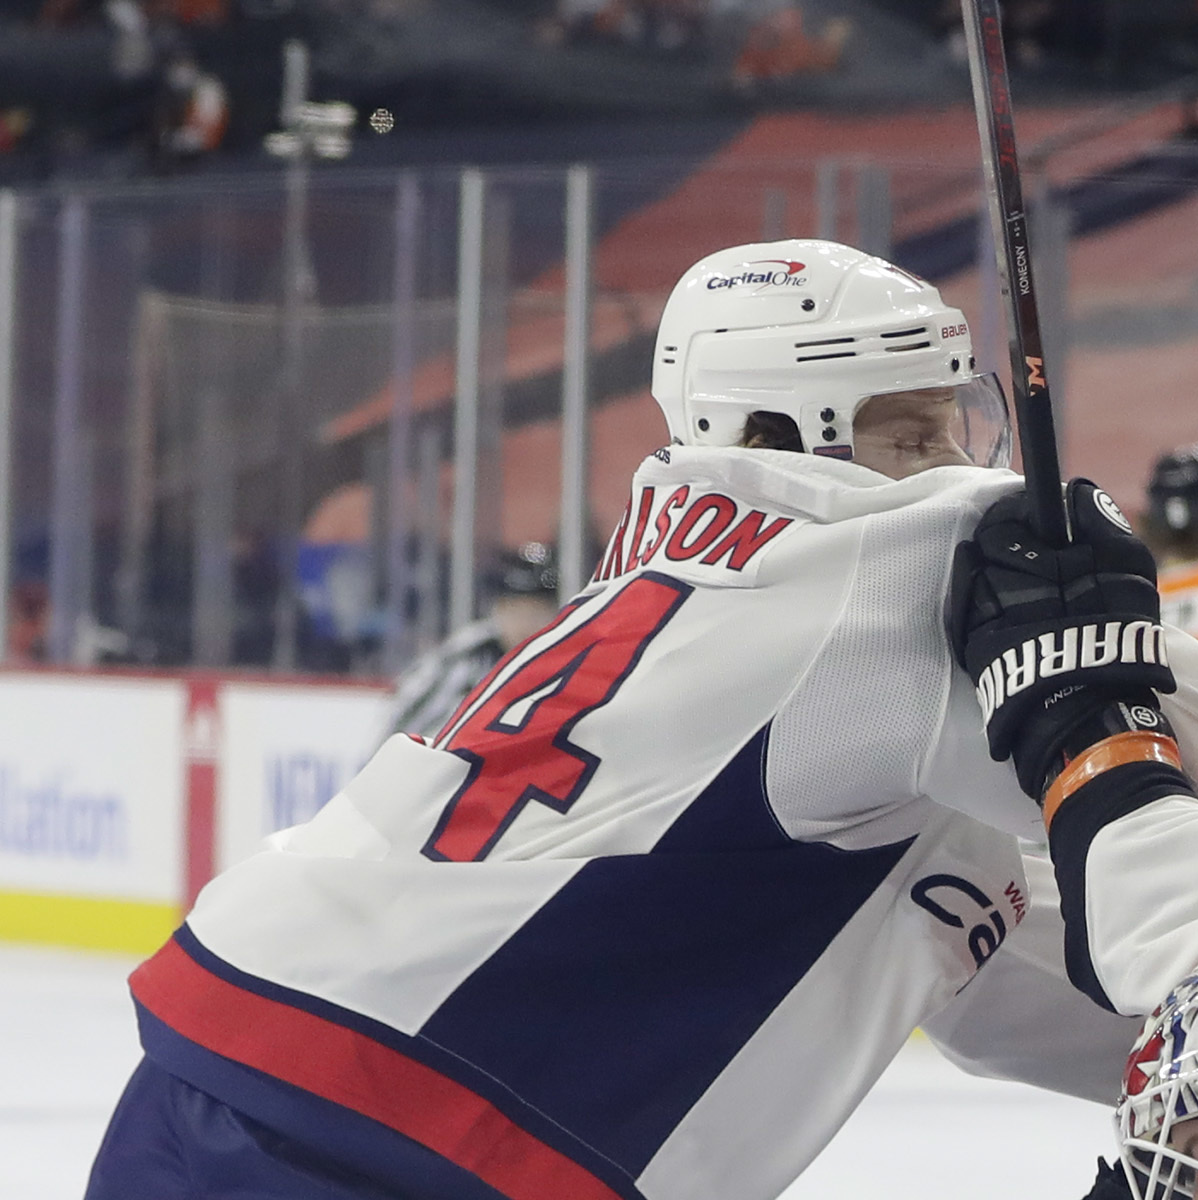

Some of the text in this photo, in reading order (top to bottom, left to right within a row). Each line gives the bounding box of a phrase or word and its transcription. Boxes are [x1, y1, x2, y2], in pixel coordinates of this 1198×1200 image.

[1015, 246, 1029, 294] KONECNY
[1025, 356, 1047, 396] M
[592, 484, 795, 583] RLSON
[418, 569, 697, 863] 4
